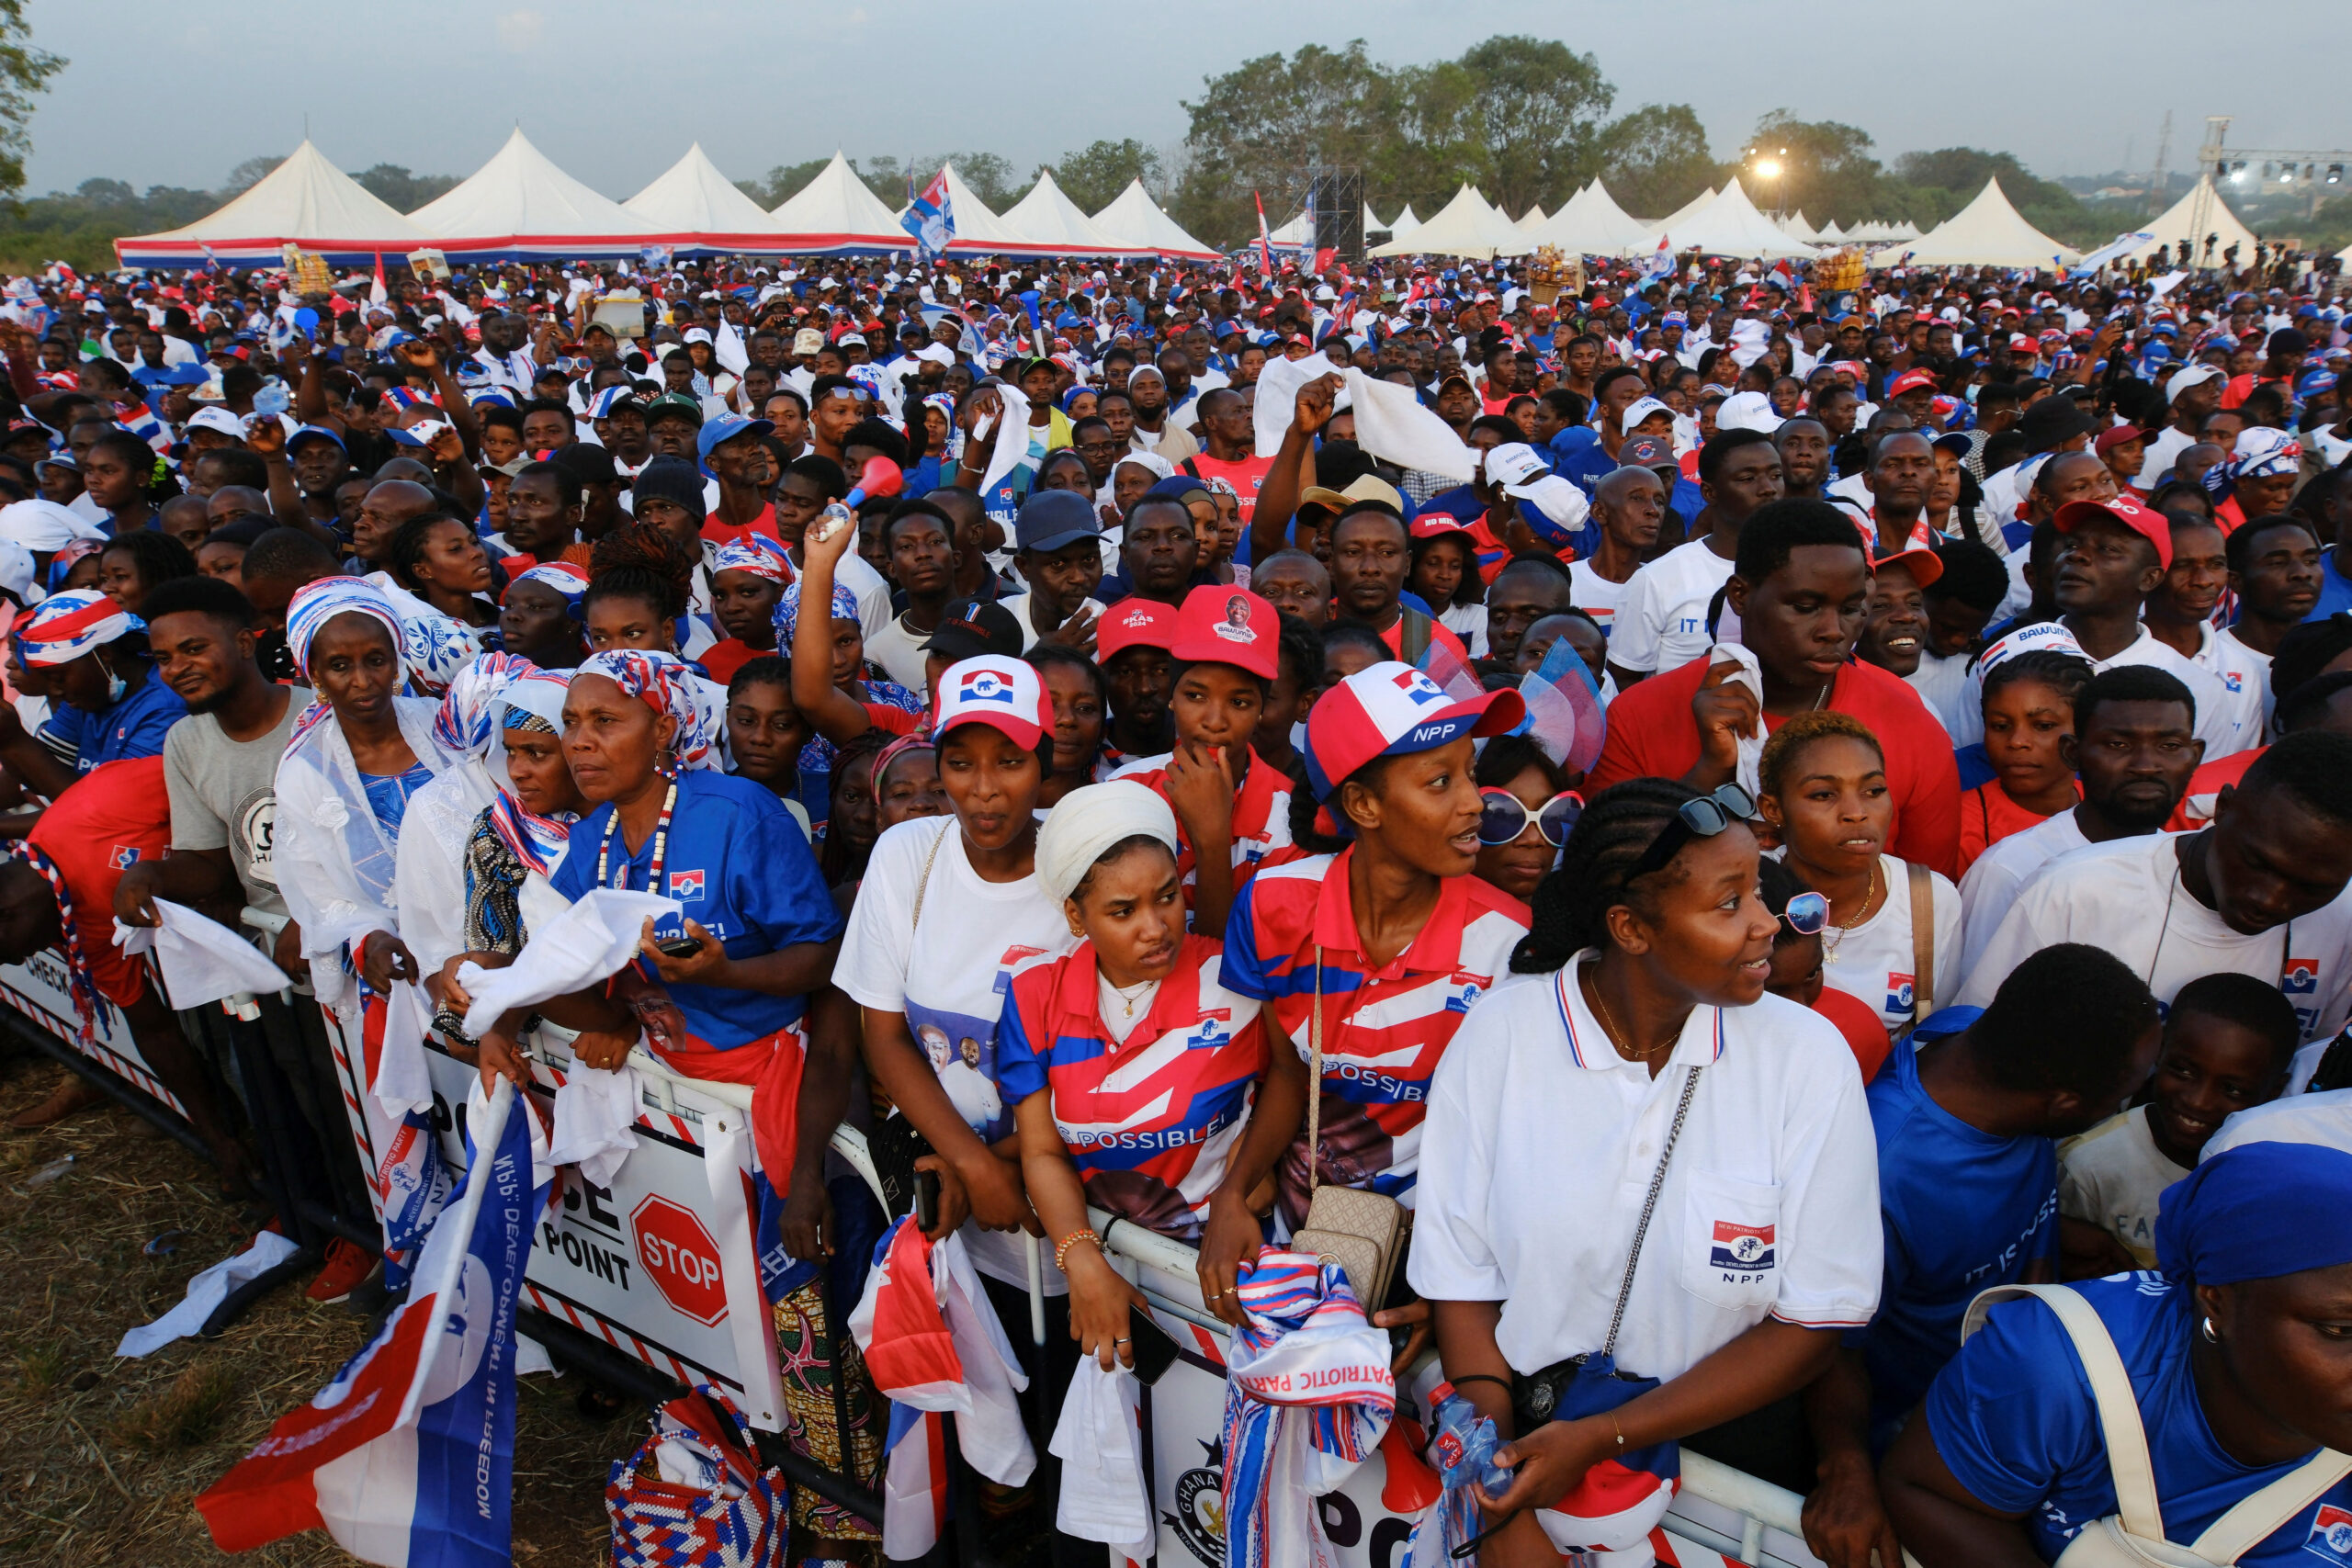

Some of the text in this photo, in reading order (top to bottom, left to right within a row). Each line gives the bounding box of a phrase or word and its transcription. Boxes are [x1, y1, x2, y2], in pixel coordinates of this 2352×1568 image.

[965, 603, 981, 622] 1
[1680, 618, 1699, 633] IT
[1217, 626, 1253, 638] BAWUMIA
[1413, 724, 1456, 742] NPP
[1322, 1061, 1430, 1105] POSSIB
[391, 1129, 407, 1155] PARTY
[407, 1184, 432, 1224] DEVELOPMENT
[1718, 1223, 1733, 1231] NEW
[1733, 1226, 1761, 1235] PATRIOTIC
[548, 1228, 631, 1292] POINT
[642, 1231, 720, 1292] STOP
[1299, 1364, 1395, 1390] PATRIOTIC
[1180, 1472, 1218, 1514] GHANA
[1179, 1531, 1204, 1560] SERVICE
